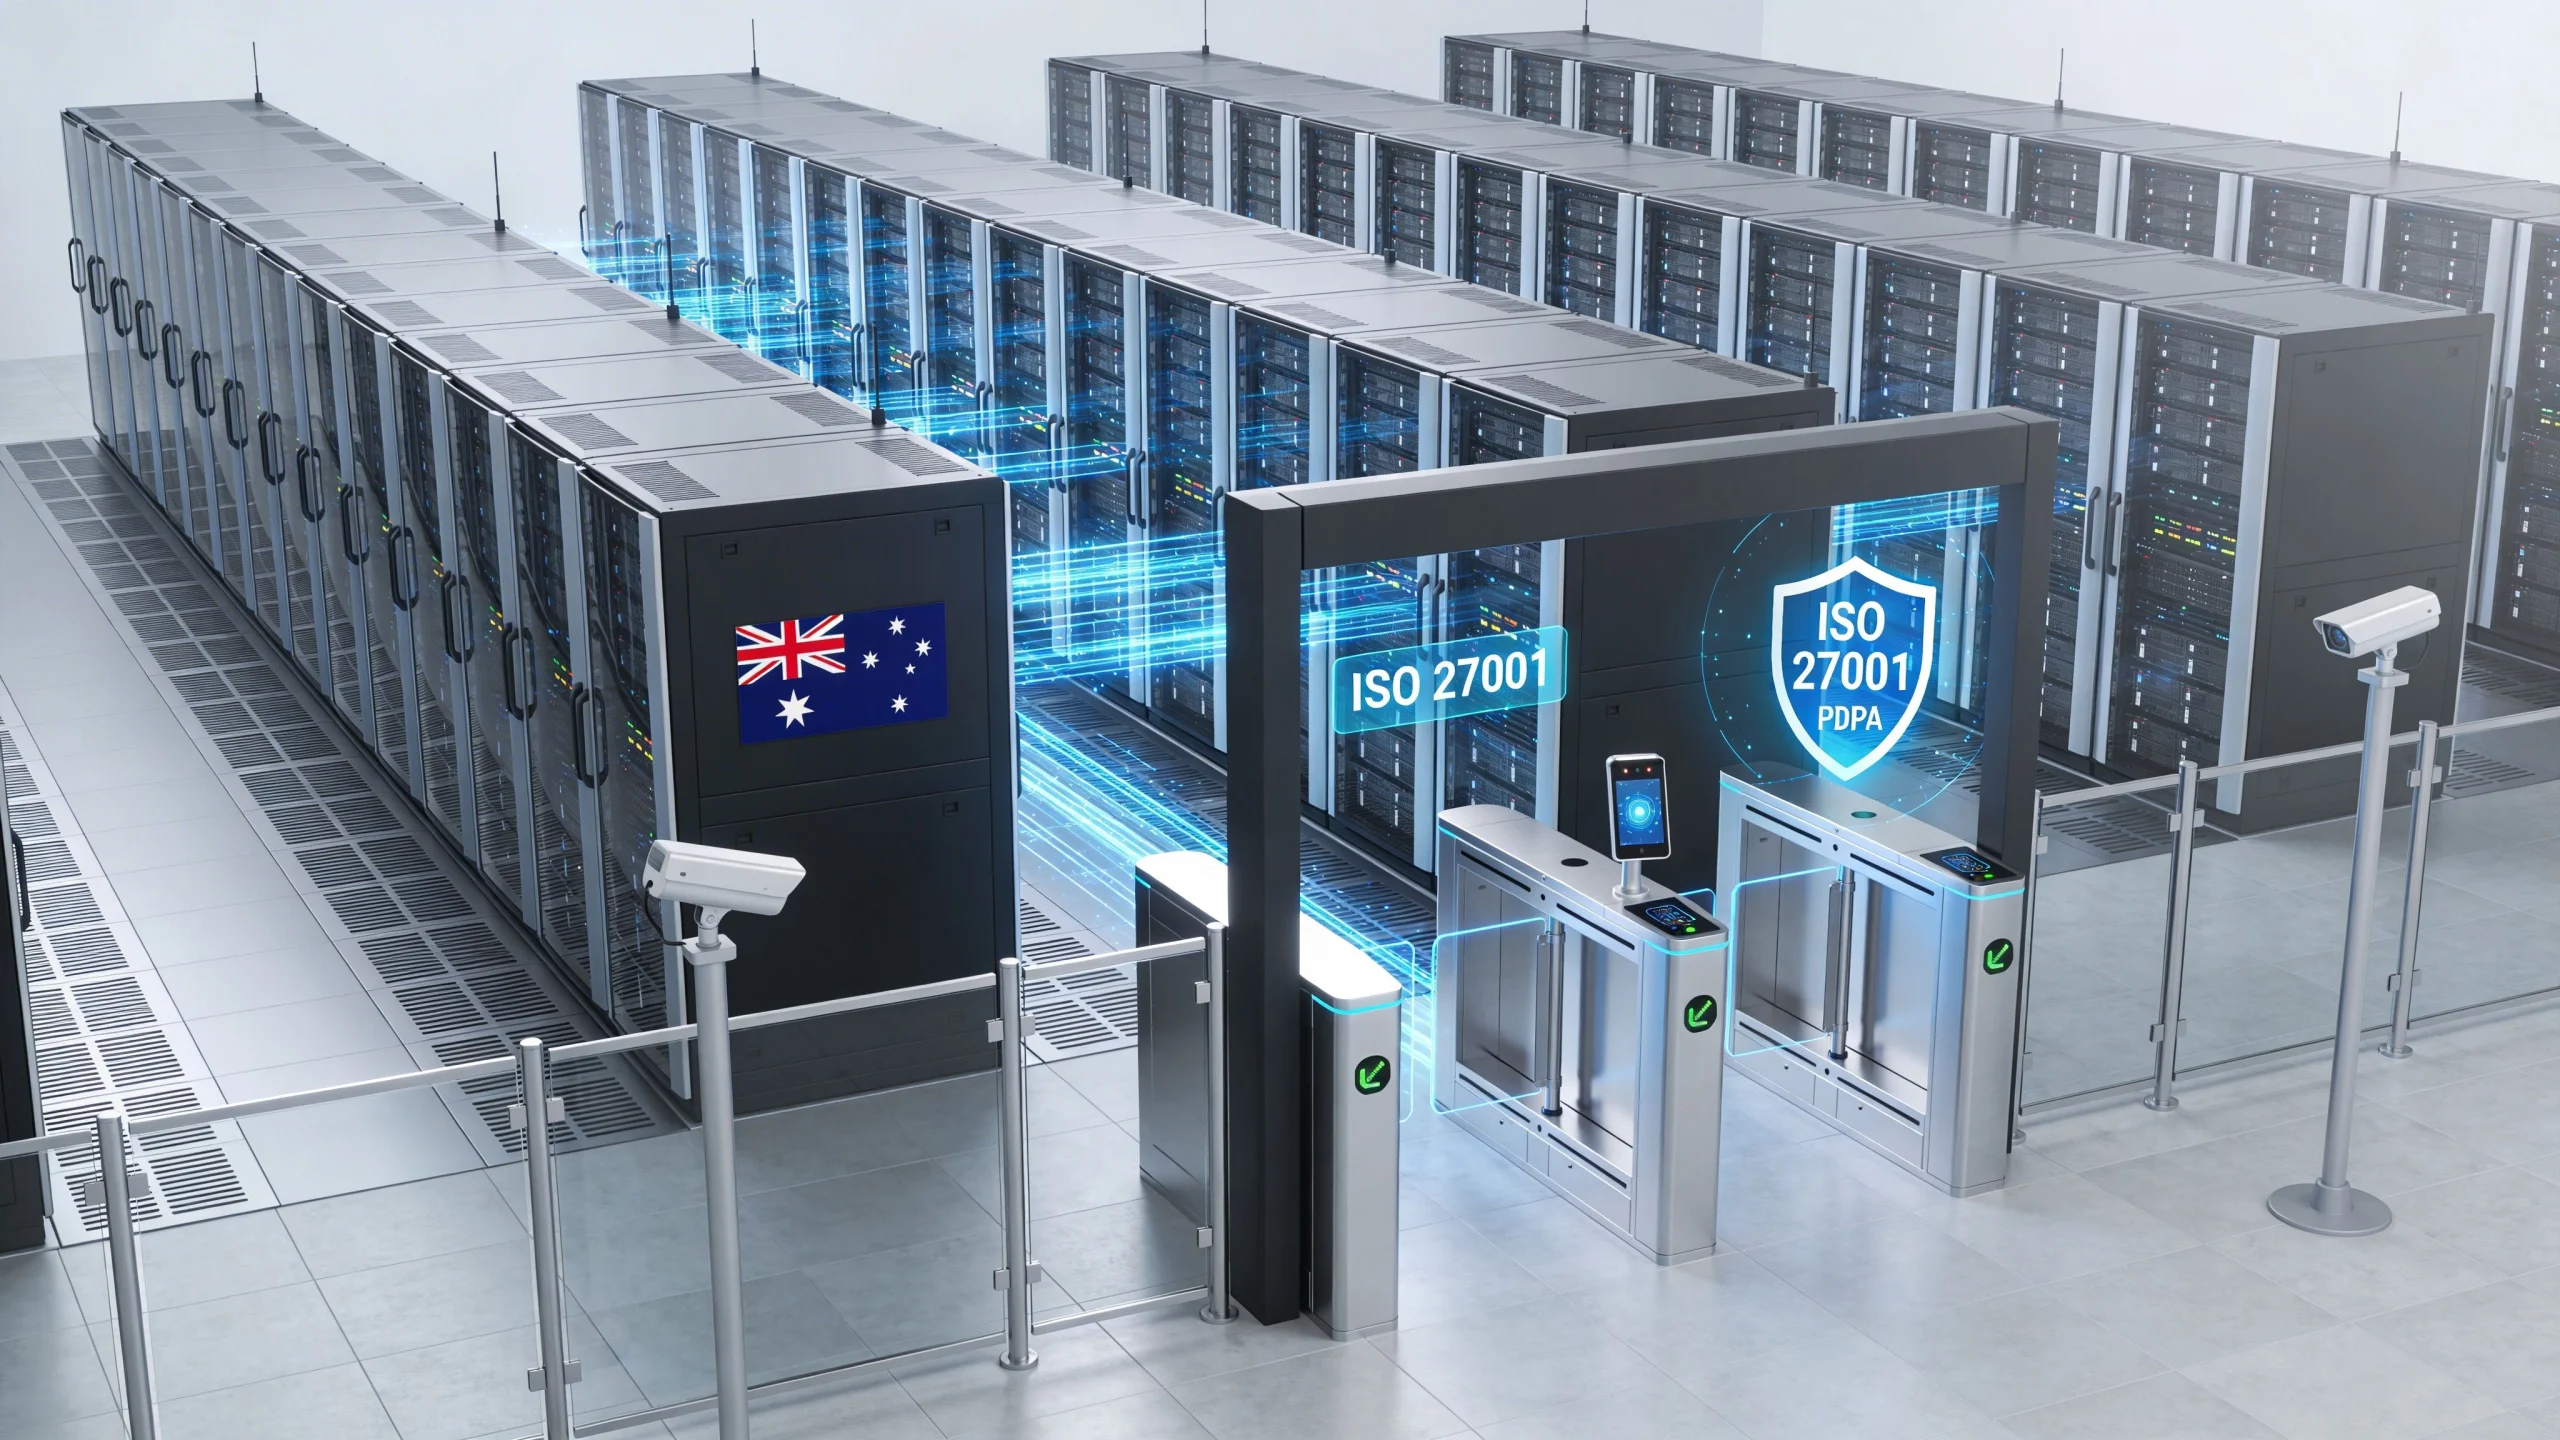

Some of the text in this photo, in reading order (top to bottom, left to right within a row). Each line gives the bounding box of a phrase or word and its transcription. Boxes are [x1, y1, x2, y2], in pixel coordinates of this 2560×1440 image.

[1818, 600, 1886, 642] ISO
[1352, 647, 1546, 712] ISO 27001
[1792, 650, 1908, 691] 27001
[1818, 705, 1883, 731] PDPA
